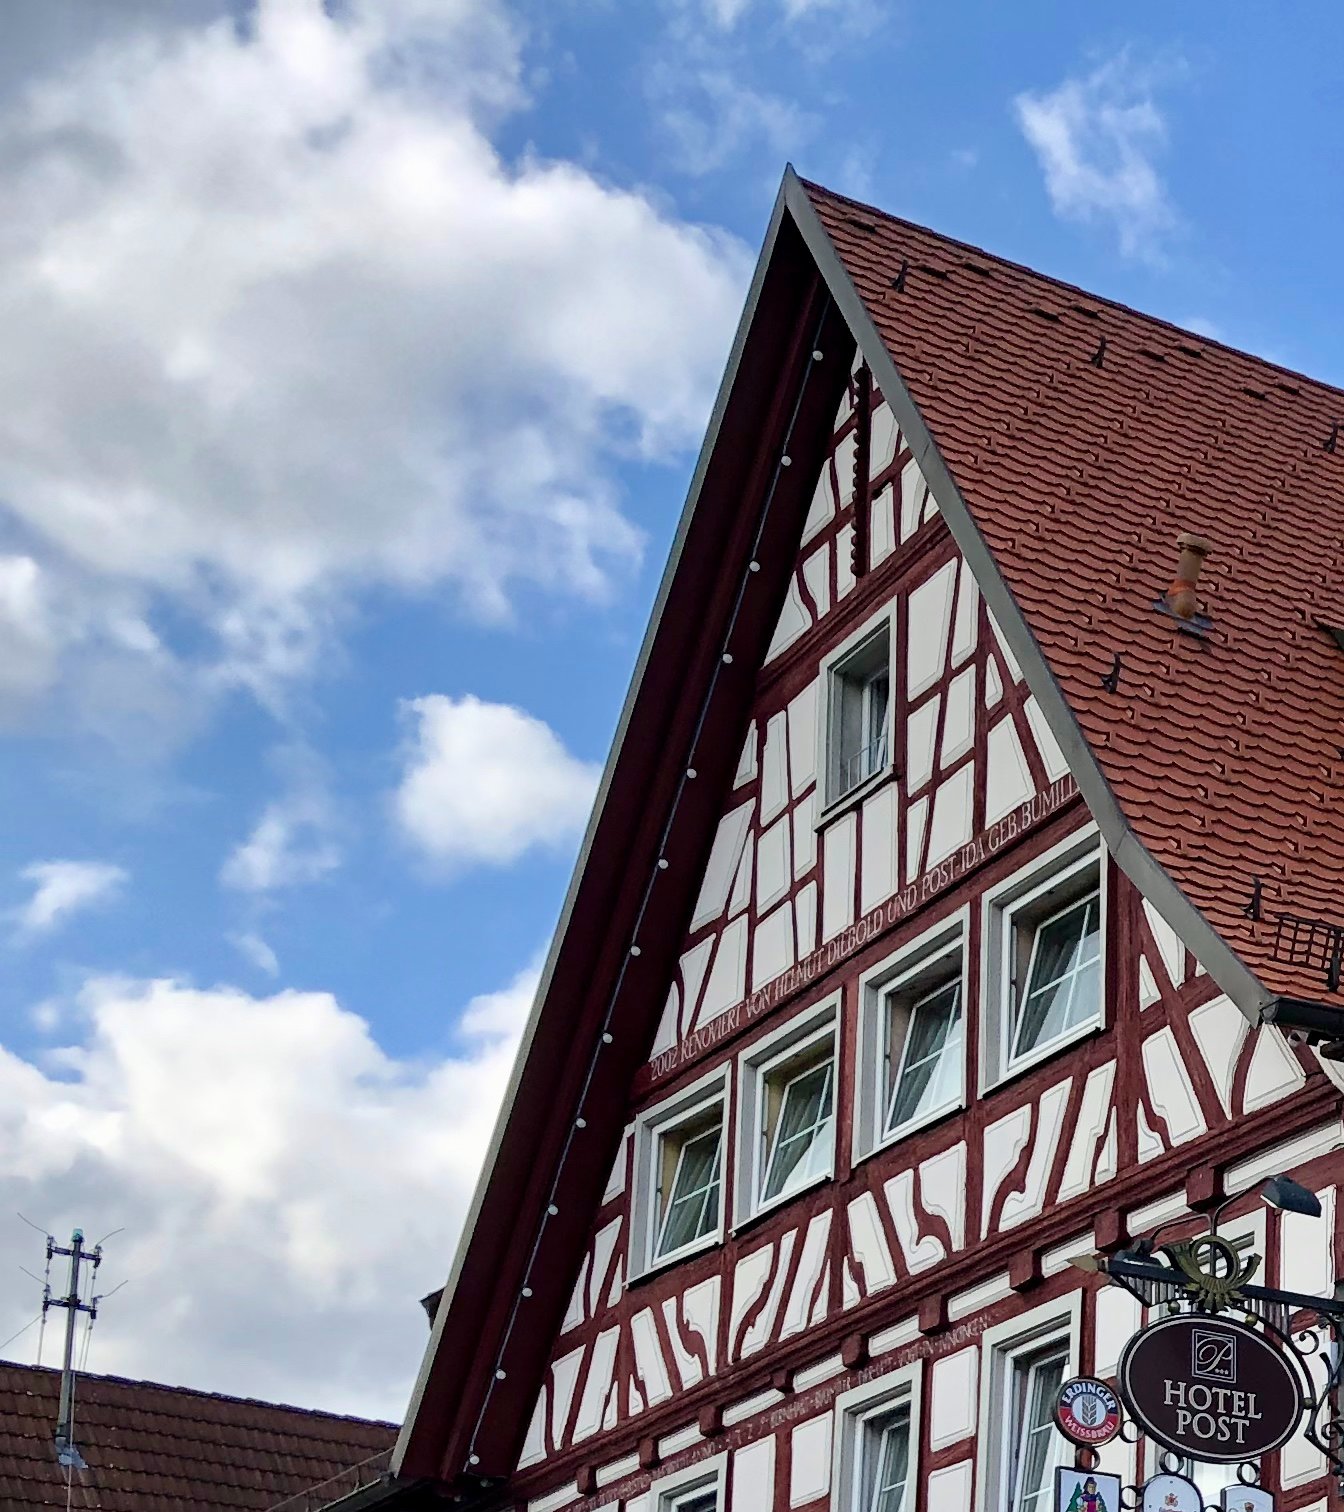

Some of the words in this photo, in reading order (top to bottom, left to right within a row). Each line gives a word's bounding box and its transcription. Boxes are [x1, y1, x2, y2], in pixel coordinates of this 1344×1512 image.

[1061, 1382, 1116, 1410] ERDINGER
[1163, 1379, 1262, 1419] HOTEL
[1176, 1408, 1250, 1444] POST
